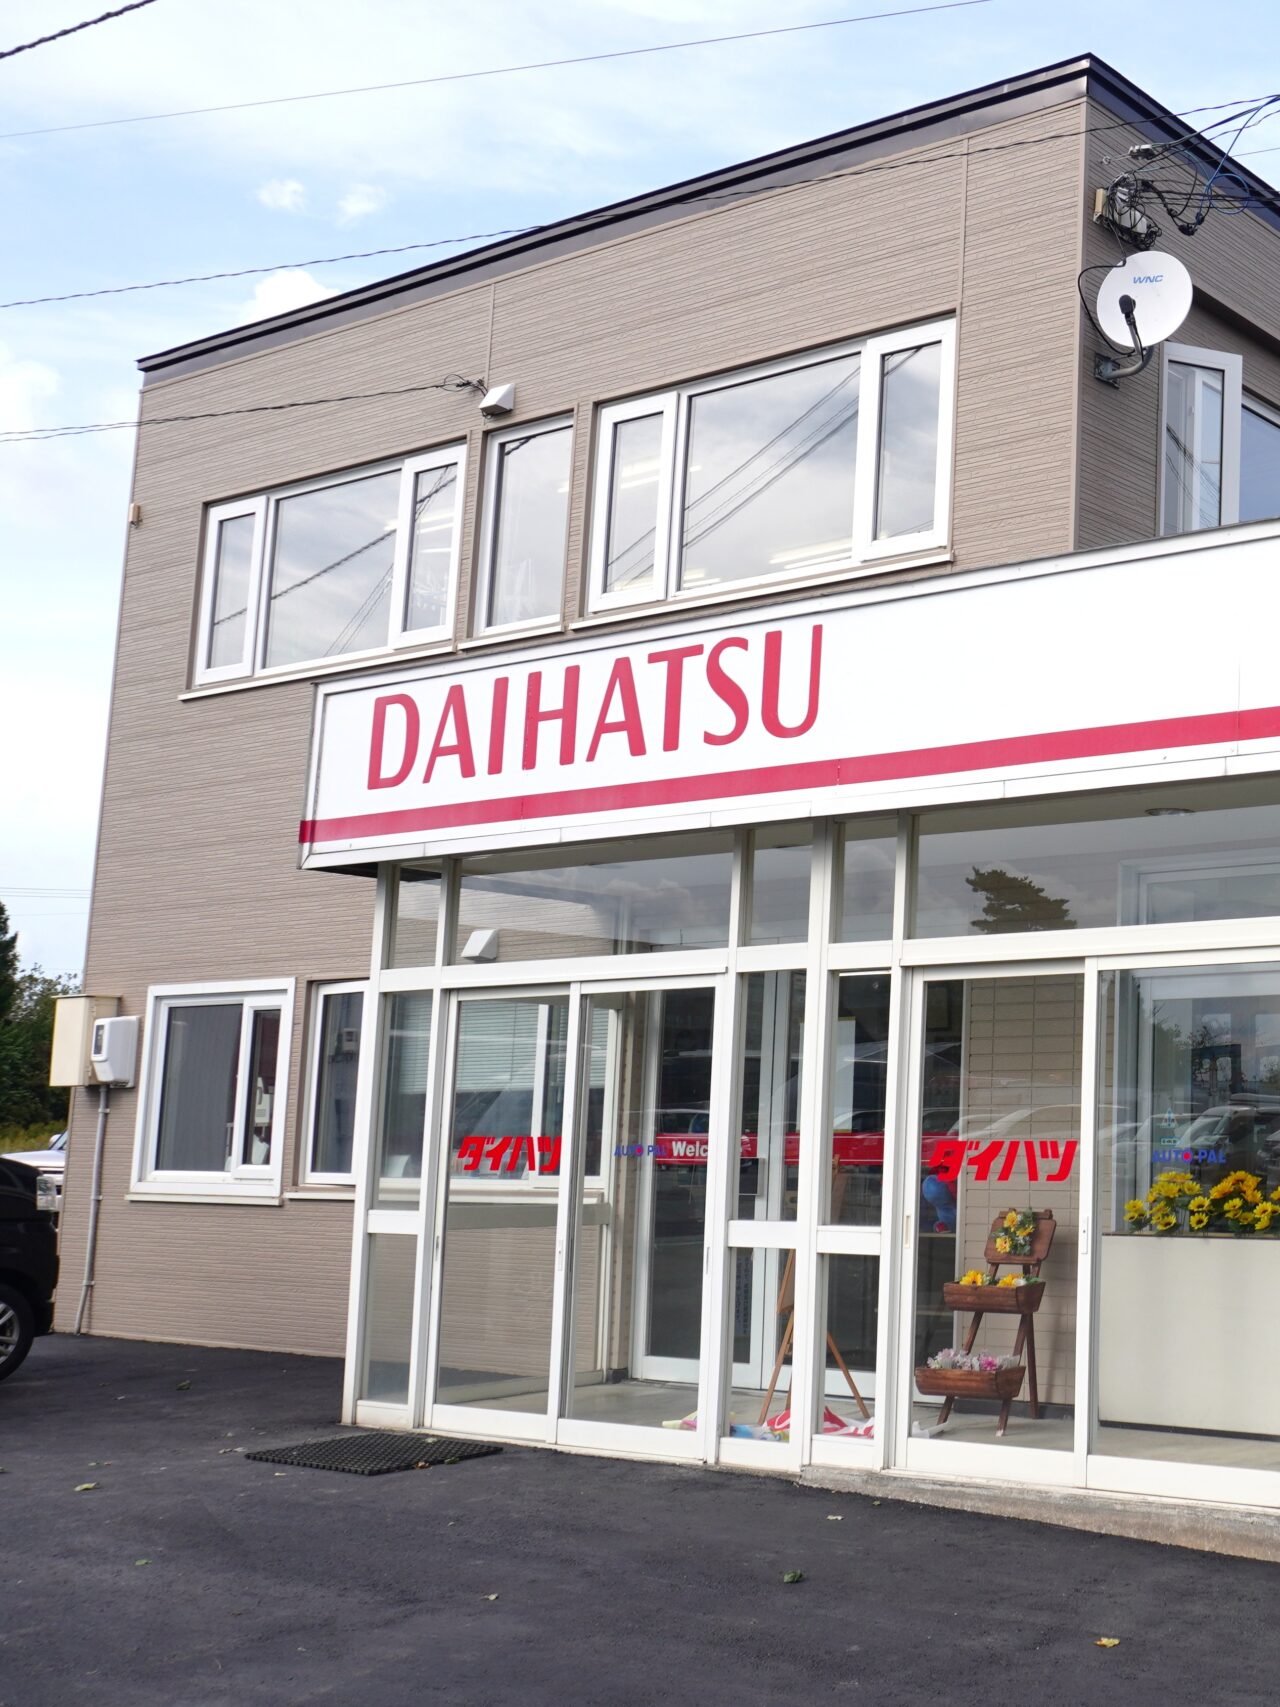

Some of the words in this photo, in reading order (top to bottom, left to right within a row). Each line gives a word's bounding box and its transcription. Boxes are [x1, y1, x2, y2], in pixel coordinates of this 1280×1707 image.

[1133, 275, 1164, 285] WNC
[366, 623, 824, 791] DAIHATSU
[457, 1135, 563, 1172] ダイハツ
[613, 1143, 644, 1158] AUTO
[671, 1140, 709, 1158] Welc
[1152, 1148, 1193, 1164] AUTO
[1198, 1149, 1227, 1164] PAL
[928, 1139, 1079, 1182] ダイハツ
